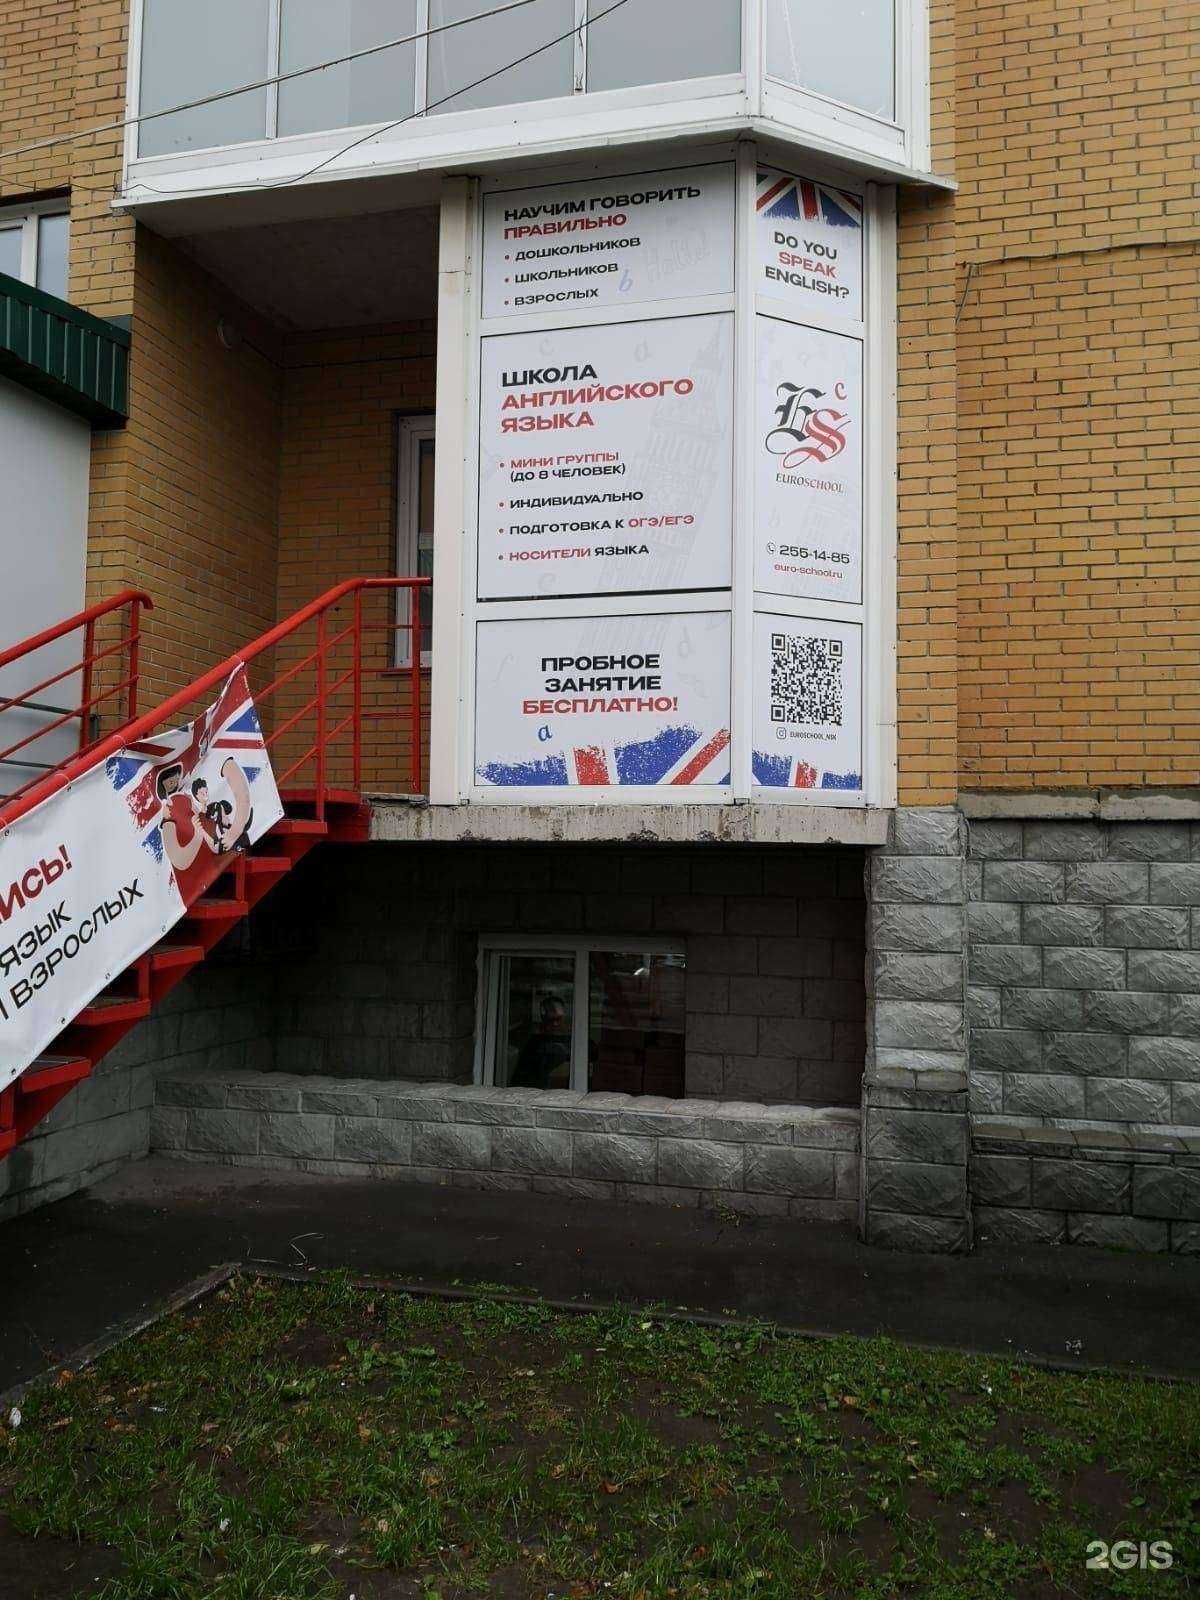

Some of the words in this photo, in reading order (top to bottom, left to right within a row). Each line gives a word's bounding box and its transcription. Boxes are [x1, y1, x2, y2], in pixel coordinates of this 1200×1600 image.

[504, 200, 585, 221] НАУЧИМ
[590, 187, 700, 210] ГОВОРИТЬ
[504, 214, 627, 239] ПРАВИЛЬНО
[515, 237, 640, 261] ДОШКОЛЬНИКОВ
[774, 232, 798, 248] DO
[804, 240, 837, 259] YOU
[515, 263, 618, 283] ШКОЛЬНИКОВ
[779, 251, 836, 278] SPEAK
[765, 266, 849, 298] ENGLISH?
[514, 288, 599, 305] ВЗРОСЛЫХ
[502, 364, 597, 387] ШКОЛА
[502, 379, 693, 410] АНГЛИЙСКОГО
[501, 411, 594, 433] ЯЗЫКА
[511, 457, 554, 468] МИНИ
[556, 452, 619, 465] ГРУППЫ
[510, 471, 535, 482] (ДО
[538, 470, 549, 480] 8
[553, 463, 625, 478] ЧЕЛОВЕК)
[775, 472, 843, 493] EUROSCHOOL
[510, 491, 643, 509] ИНДИВИДУАЛЬНО
[509, 520, 611, 535] ПОДГОТОВКА
[615, 519, 624, 528] К
[628, 515, 694, 528] ОГЭ/ЕГЭ
[509, 548, 591, 561] НОСИТЕЛИ
[594, 545, 649, 556] ЯЗЫКА
[780, 544, 850, 564] 255-14-85
[541, 654, 660, 672] ПРОБНОЕ
[545, 676, 661, 693] ЗАНЯТИЕ
[523, 697, 678, 715] БЕСПЛАТНО!
[0, 900, 72, 977] ЯЗЫК
[10, 879, 144, 1009] ВЗРОСЛЫХ
